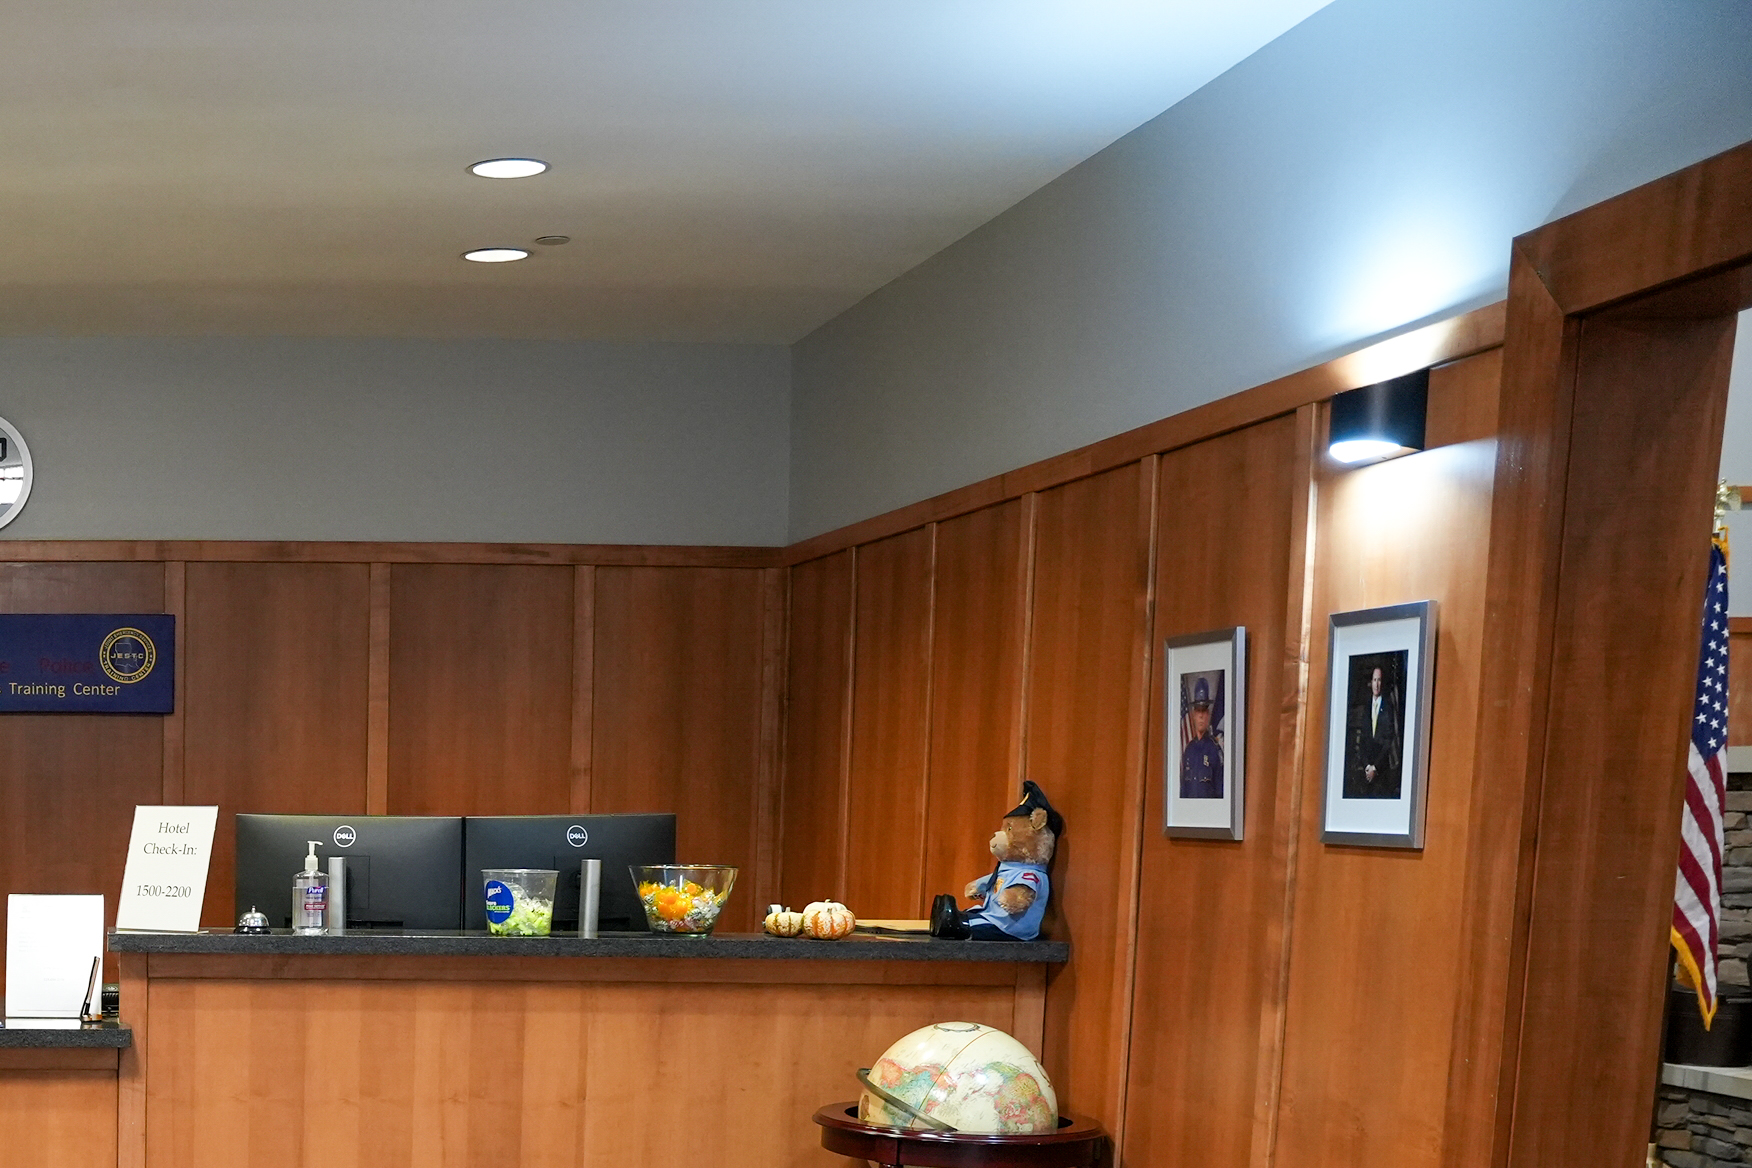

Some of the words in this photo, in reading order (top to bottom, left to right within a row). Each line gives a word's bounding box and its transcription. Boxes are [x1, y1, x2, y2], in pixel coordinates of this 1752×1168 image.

[9, 682, 66, 698] Training
[73, 682, 121, 696] Center
[158, 822, 190, 834] Hotel
[569, 832, 586, 840] DELL
[143, 842, 198, 855] Check-In:
[136, 884, 192, 898] 1500-2200
